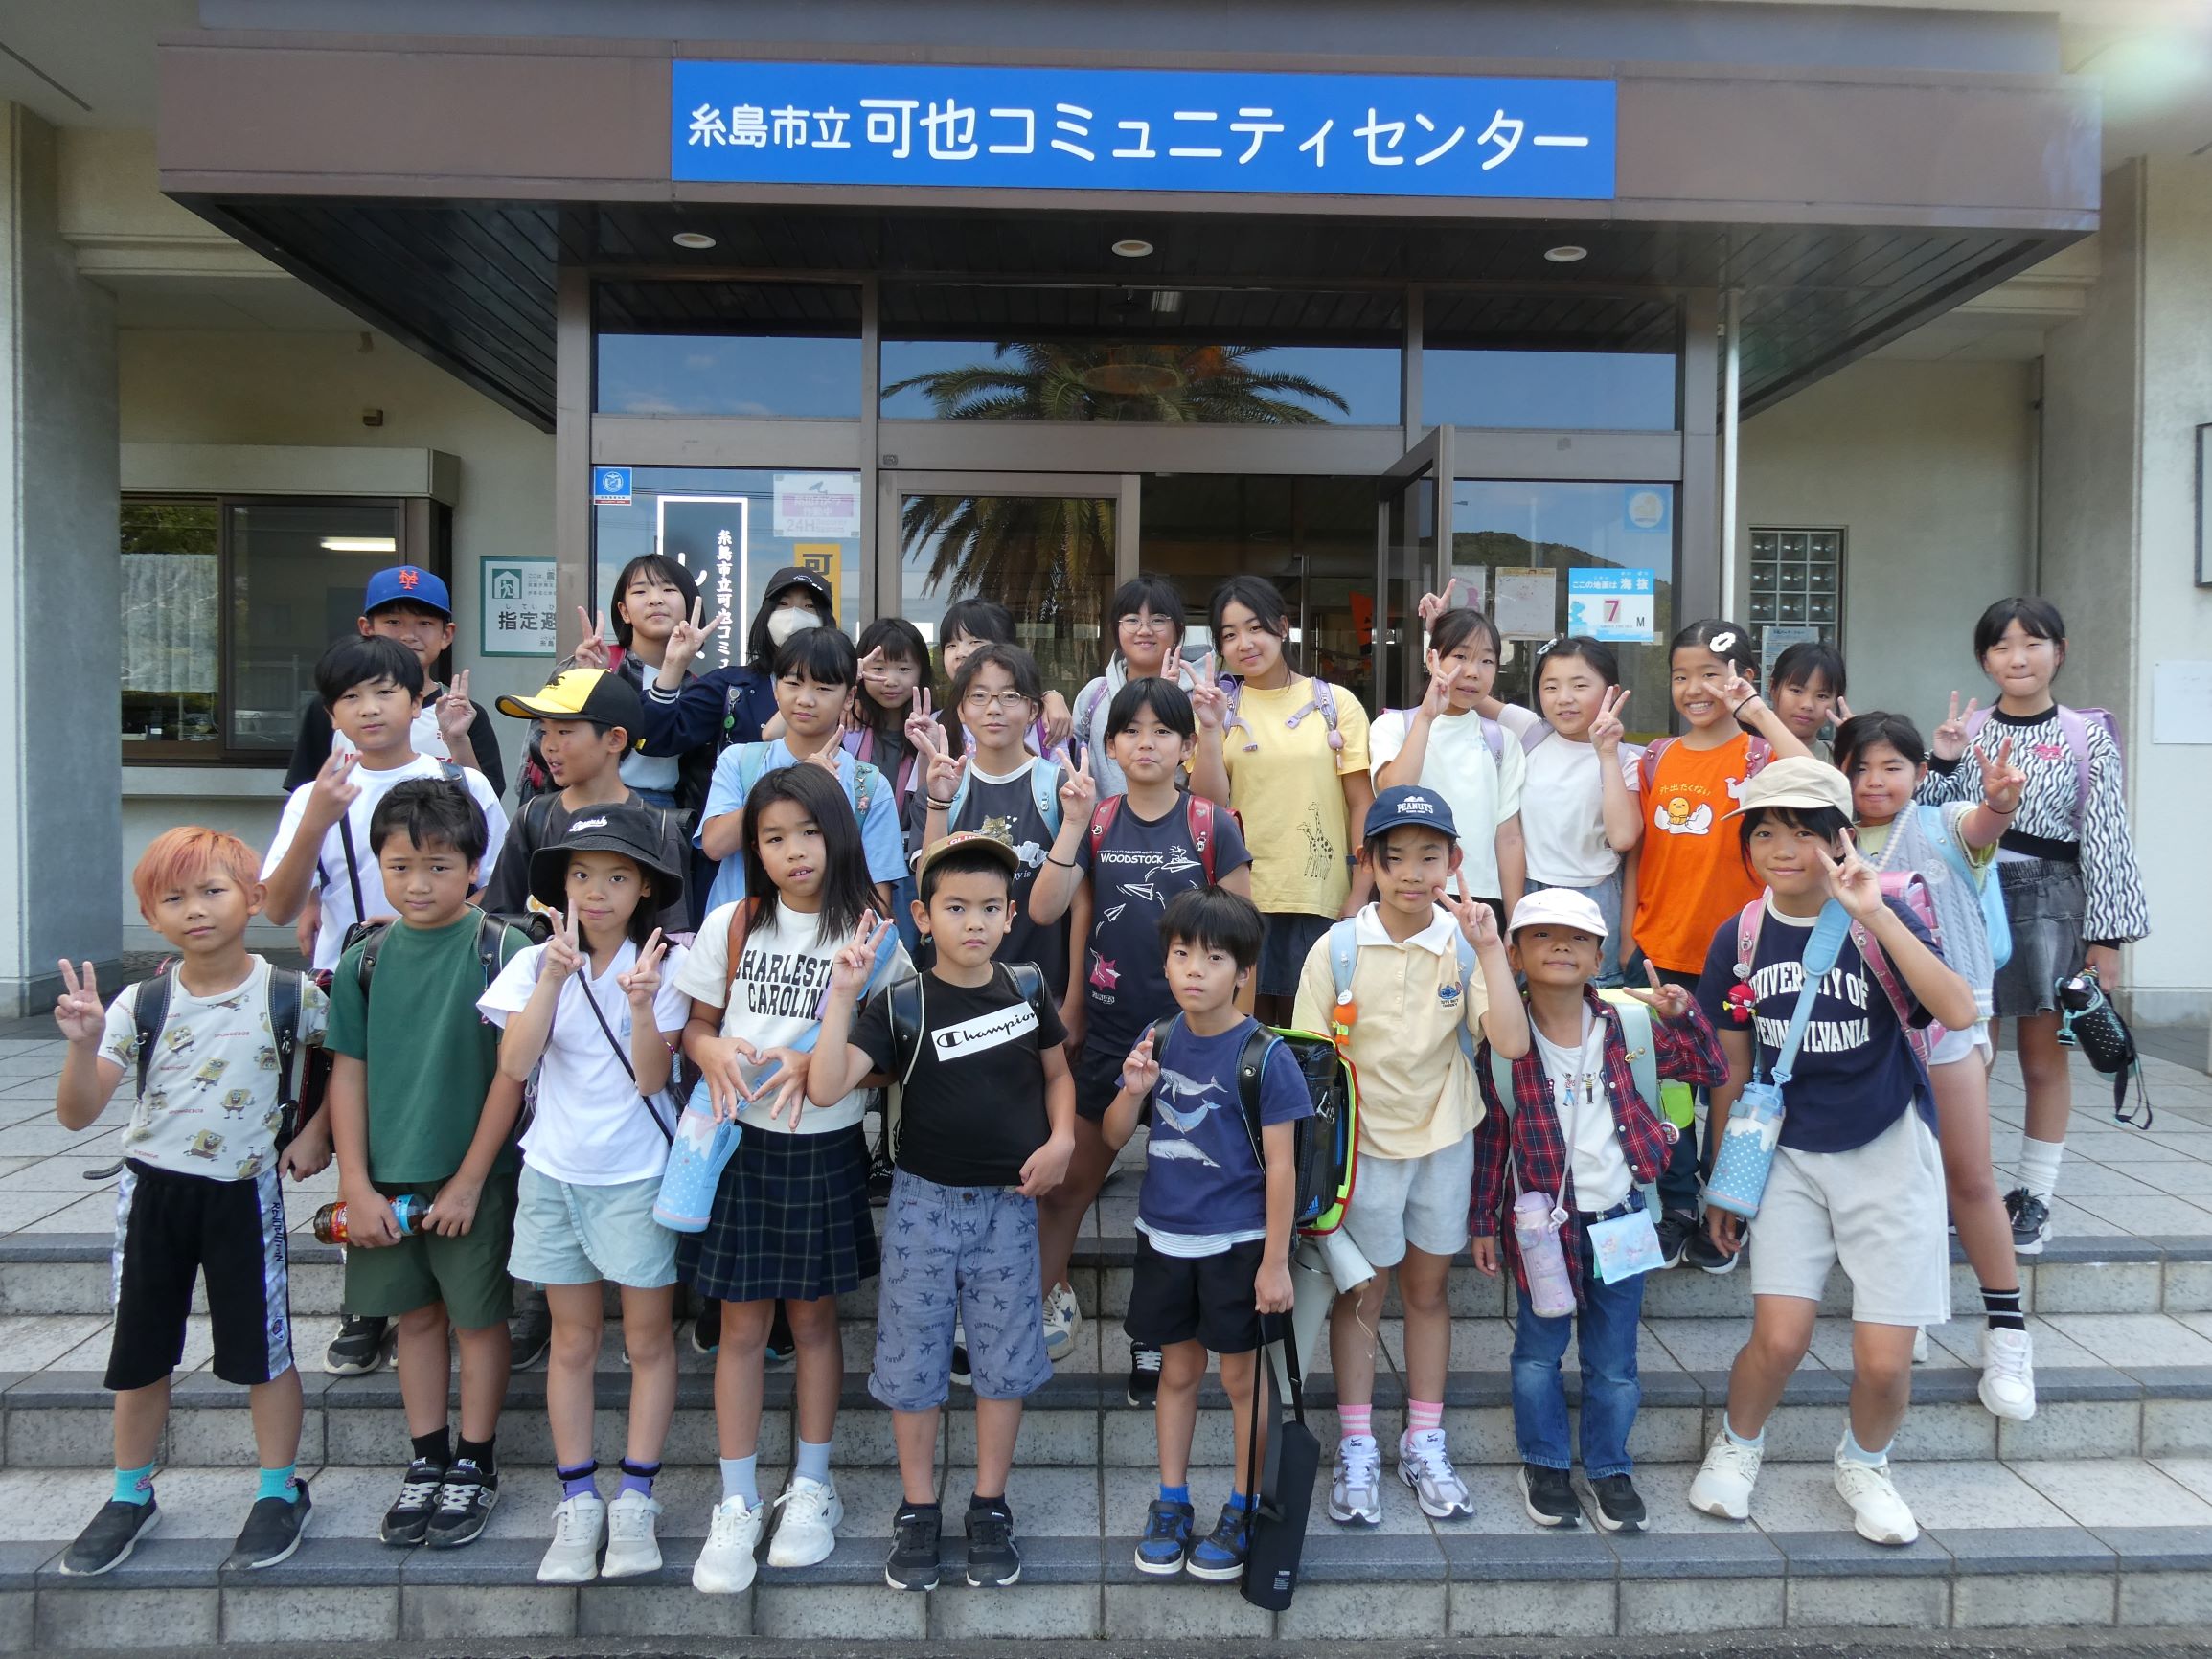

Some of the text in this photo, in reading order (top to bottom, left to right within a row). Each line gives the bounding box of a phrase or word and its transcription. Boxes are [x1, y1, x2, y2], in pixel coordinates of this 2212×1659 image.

[1605, 600, 1620, 622] 7
[1636, 616, 1646, 627] M
[1396, 802, 1434, 814] PEANUTS
[1100, 852, 1164, 864] WOODSTOCK
[735, 949, 833, 989] HARLEST
[1754, 1016, 1870, 1053] PENNYLVANIA
